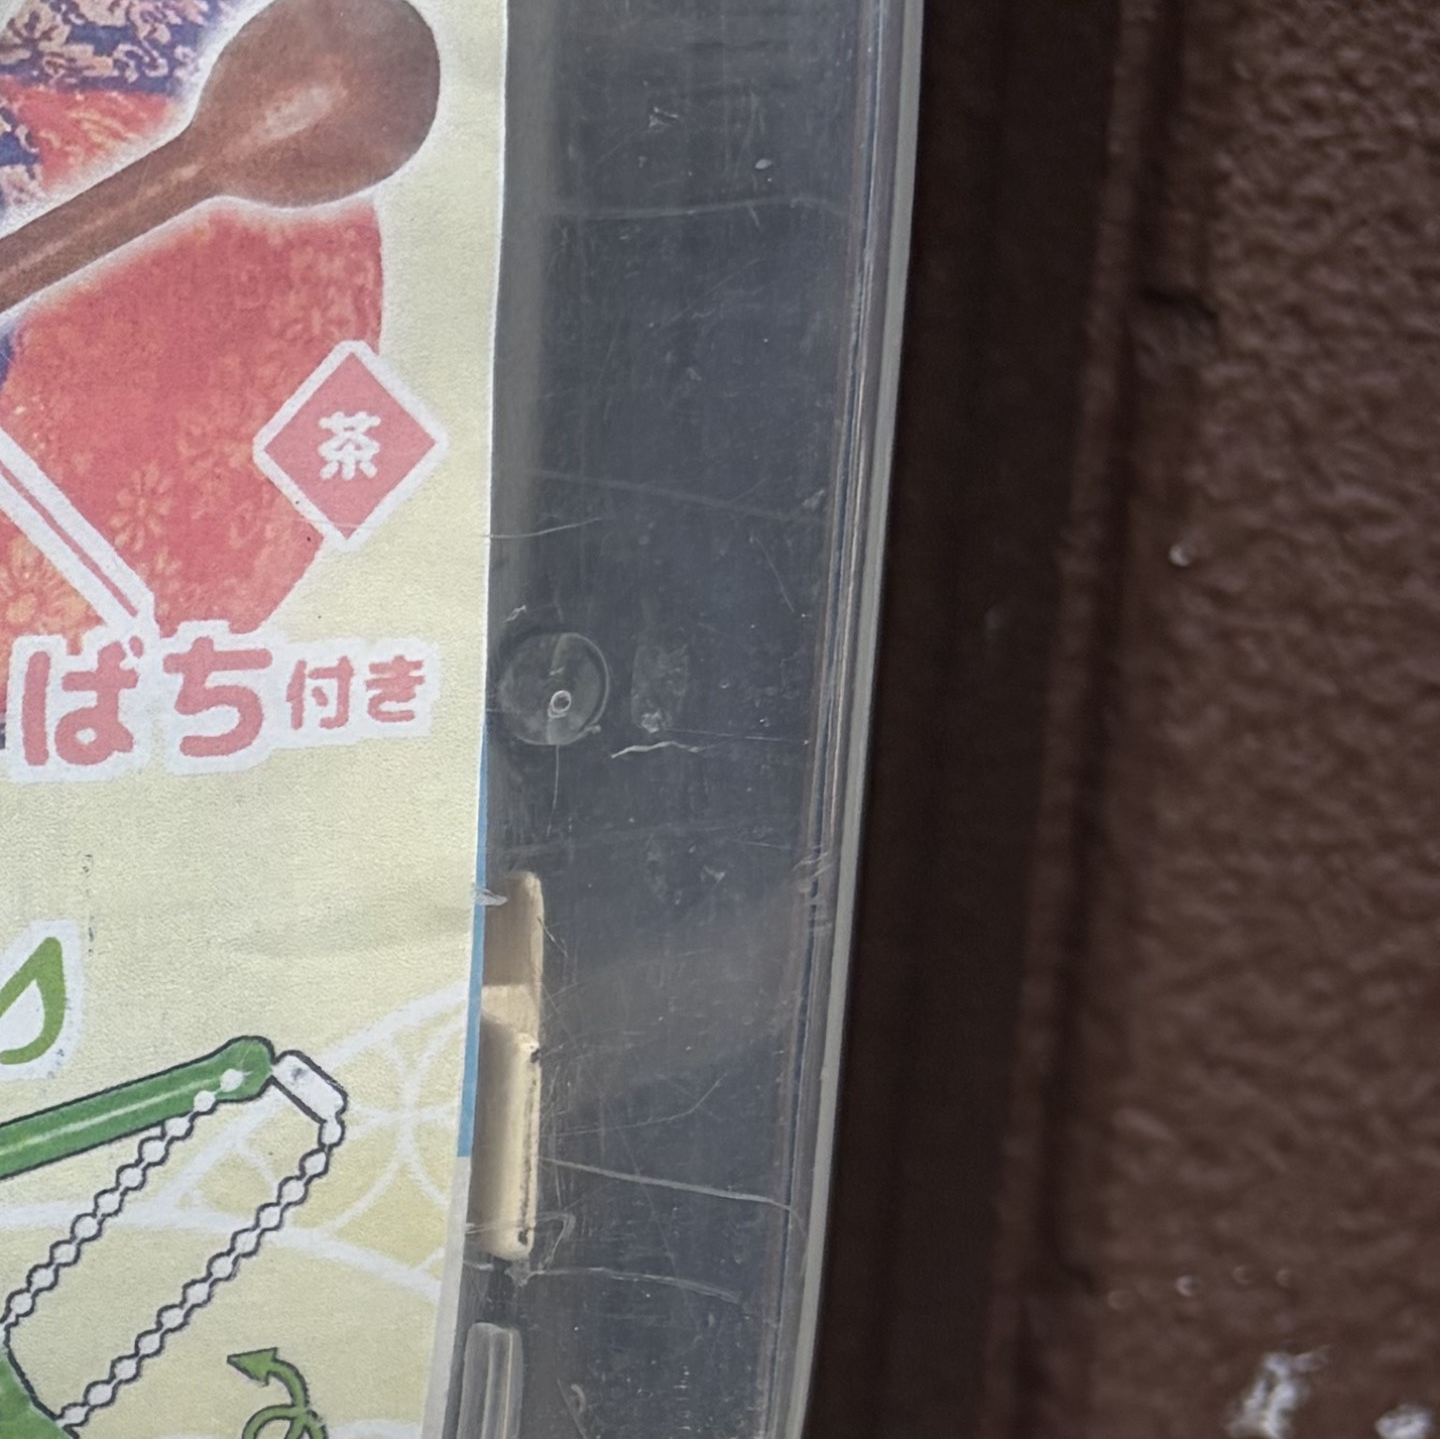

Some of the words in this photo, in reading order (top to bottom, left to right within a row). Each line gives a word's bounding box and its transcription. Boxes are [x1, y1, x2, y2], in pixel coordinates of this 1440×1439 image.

[318, 410, 380, 480] 茶
[21, 634, 426, 766] ばち付き
